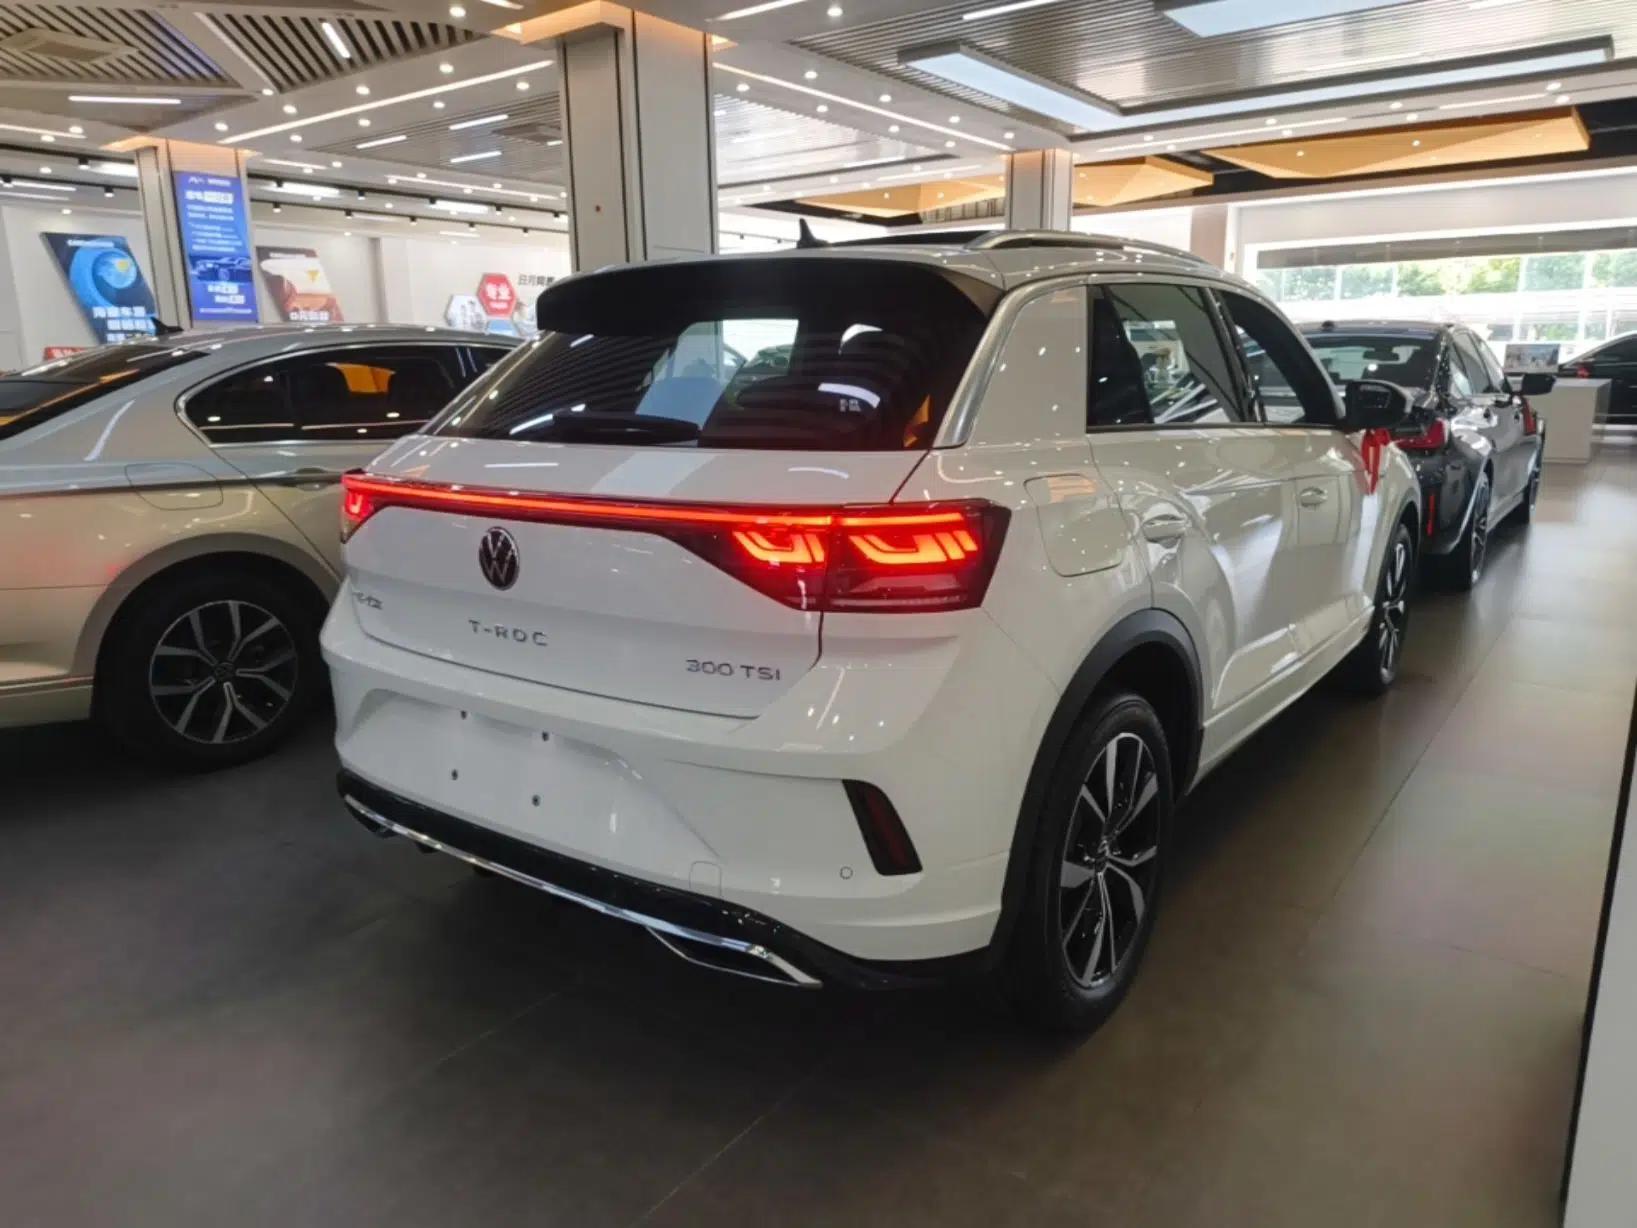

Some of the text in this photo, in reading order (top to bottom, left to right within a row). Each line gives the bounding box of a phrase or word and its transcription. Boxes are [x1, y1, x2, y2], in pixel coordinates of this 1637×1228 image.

[468, 619, 548, 647] T-ROC
[686, 659, 781, 681] 300 TSI
